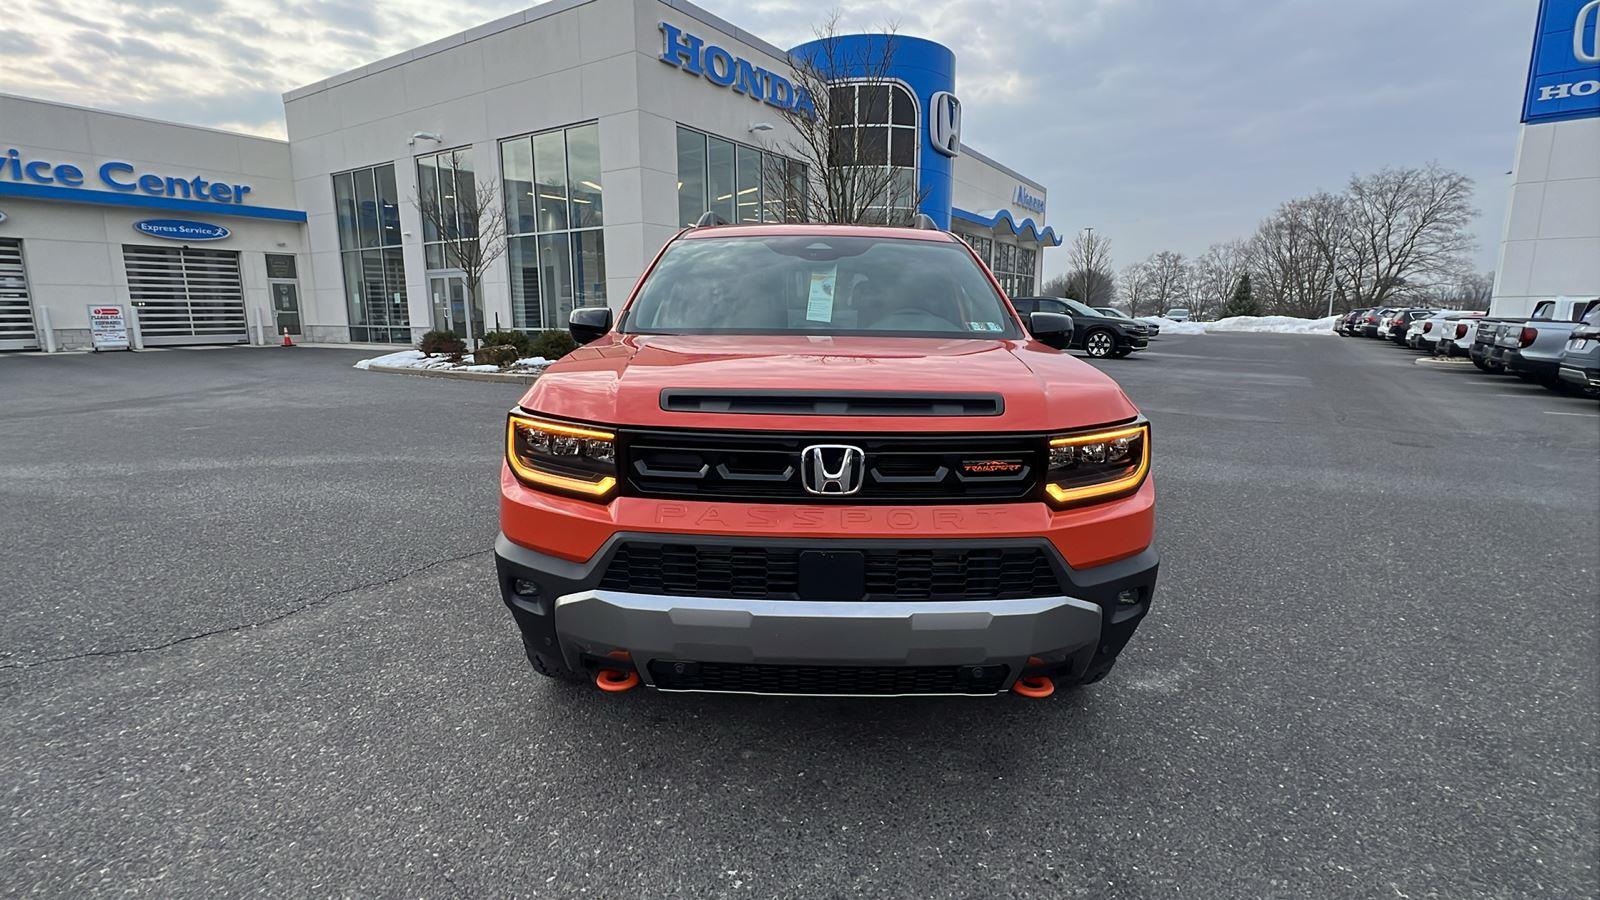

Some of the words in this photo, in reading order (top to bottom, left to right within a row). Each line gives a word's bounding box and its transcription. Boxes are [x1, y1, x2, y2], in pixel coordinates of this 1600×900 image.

[658, 22, 819, 122] HONDA
[1537, 80, 1600, 101] HO
[99, 161, 252, 204] Center
[141, 222, 177, 232] Express
[179, 225, 212, 234] Service
[964, 464, 1021, 472] TRAILSPORT
[654, 502, 1008, 530] PASSPORT
